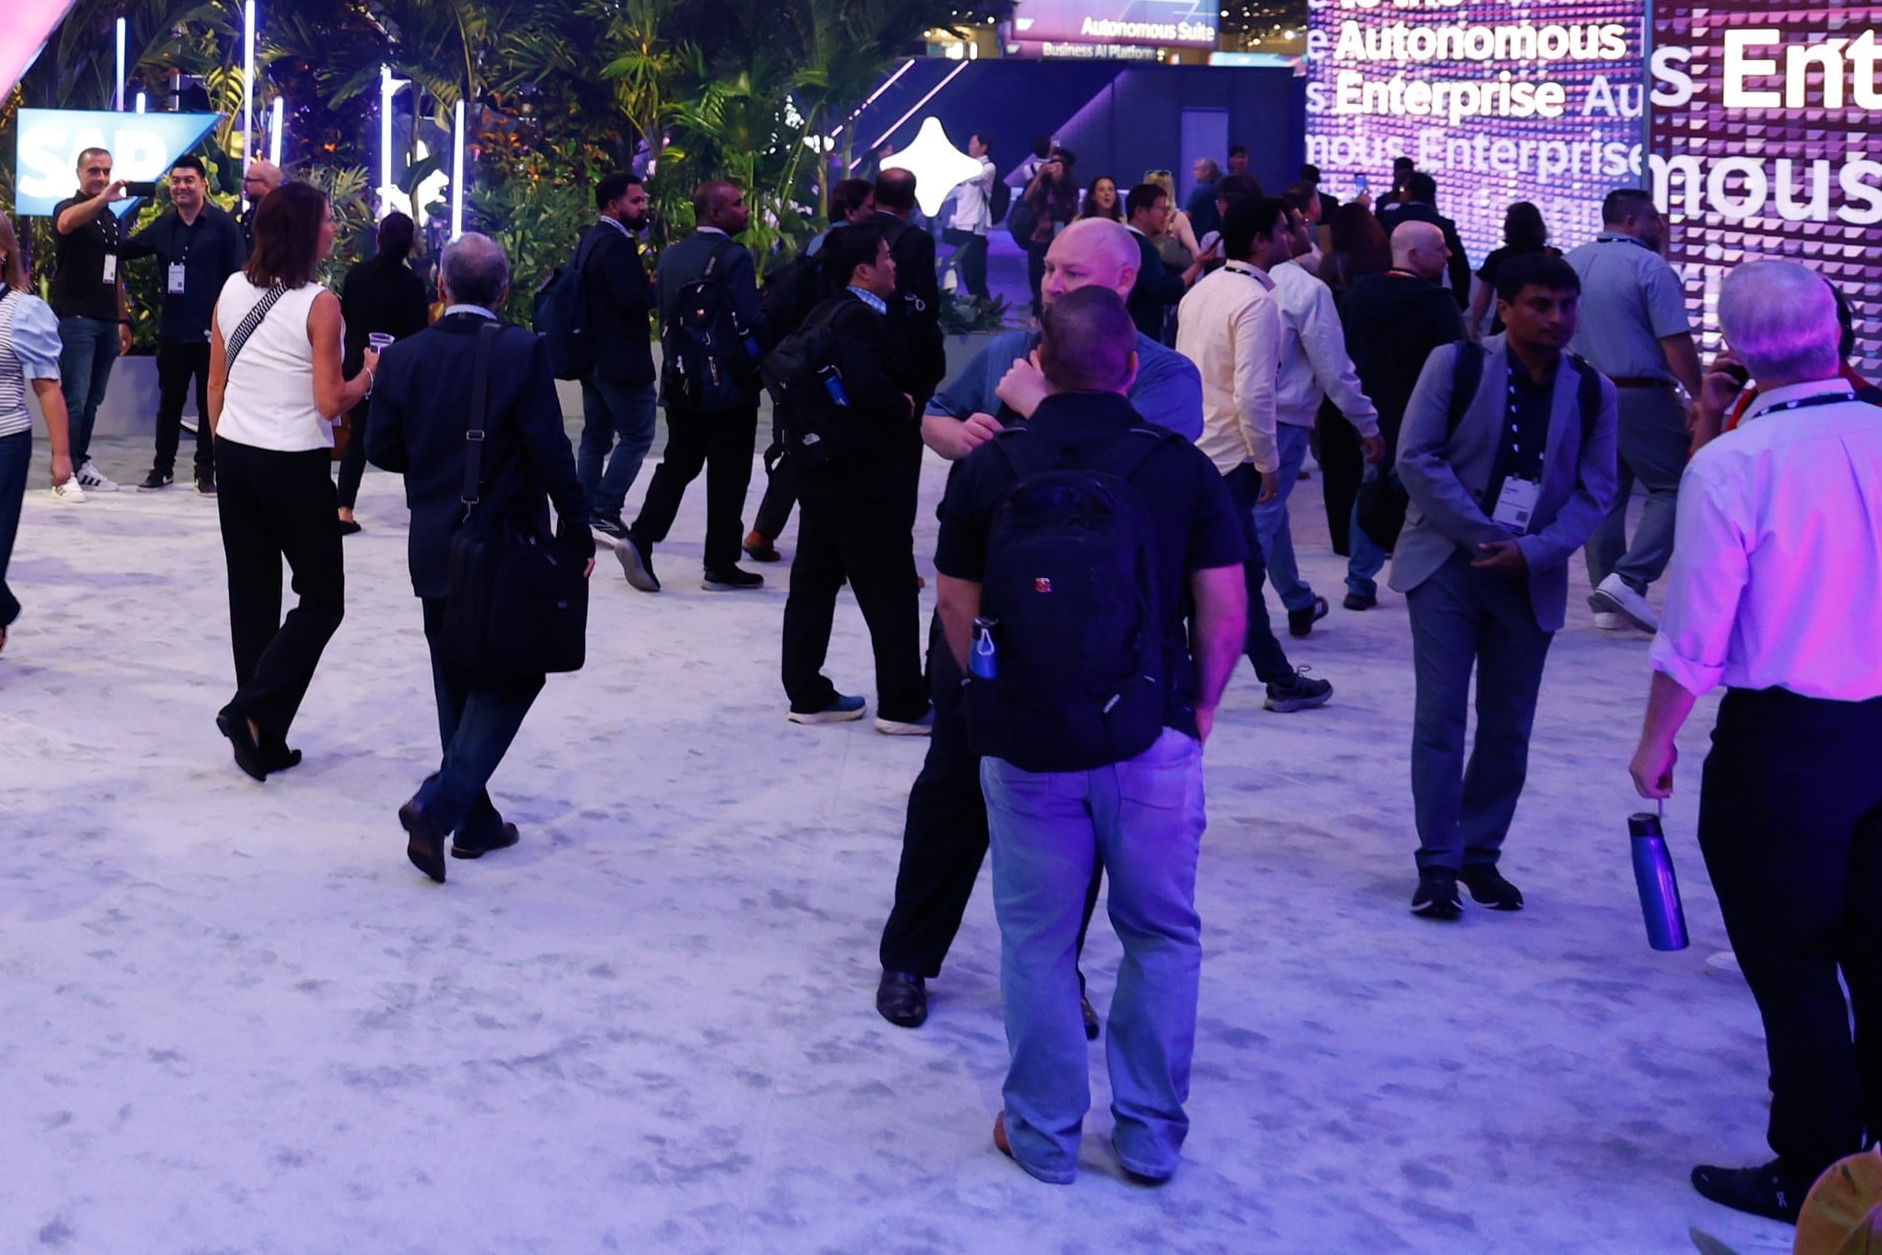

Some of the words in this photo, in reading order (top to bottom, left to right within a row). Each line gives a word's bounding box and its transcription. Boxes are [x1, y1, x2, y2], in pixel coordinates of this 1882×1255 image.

[1081, 17, 1176, 40] Autonomous
[1178, 21, 1215, 42] Suite
[1334, 21, 1627, 61] Autonomous
[1042, 42, 1093, 58] Business
[1108, 44, 1156, 59] Platform
[1335, 71, 1567, 126] Enterprise
[18, 125, 168, 200] SAP
